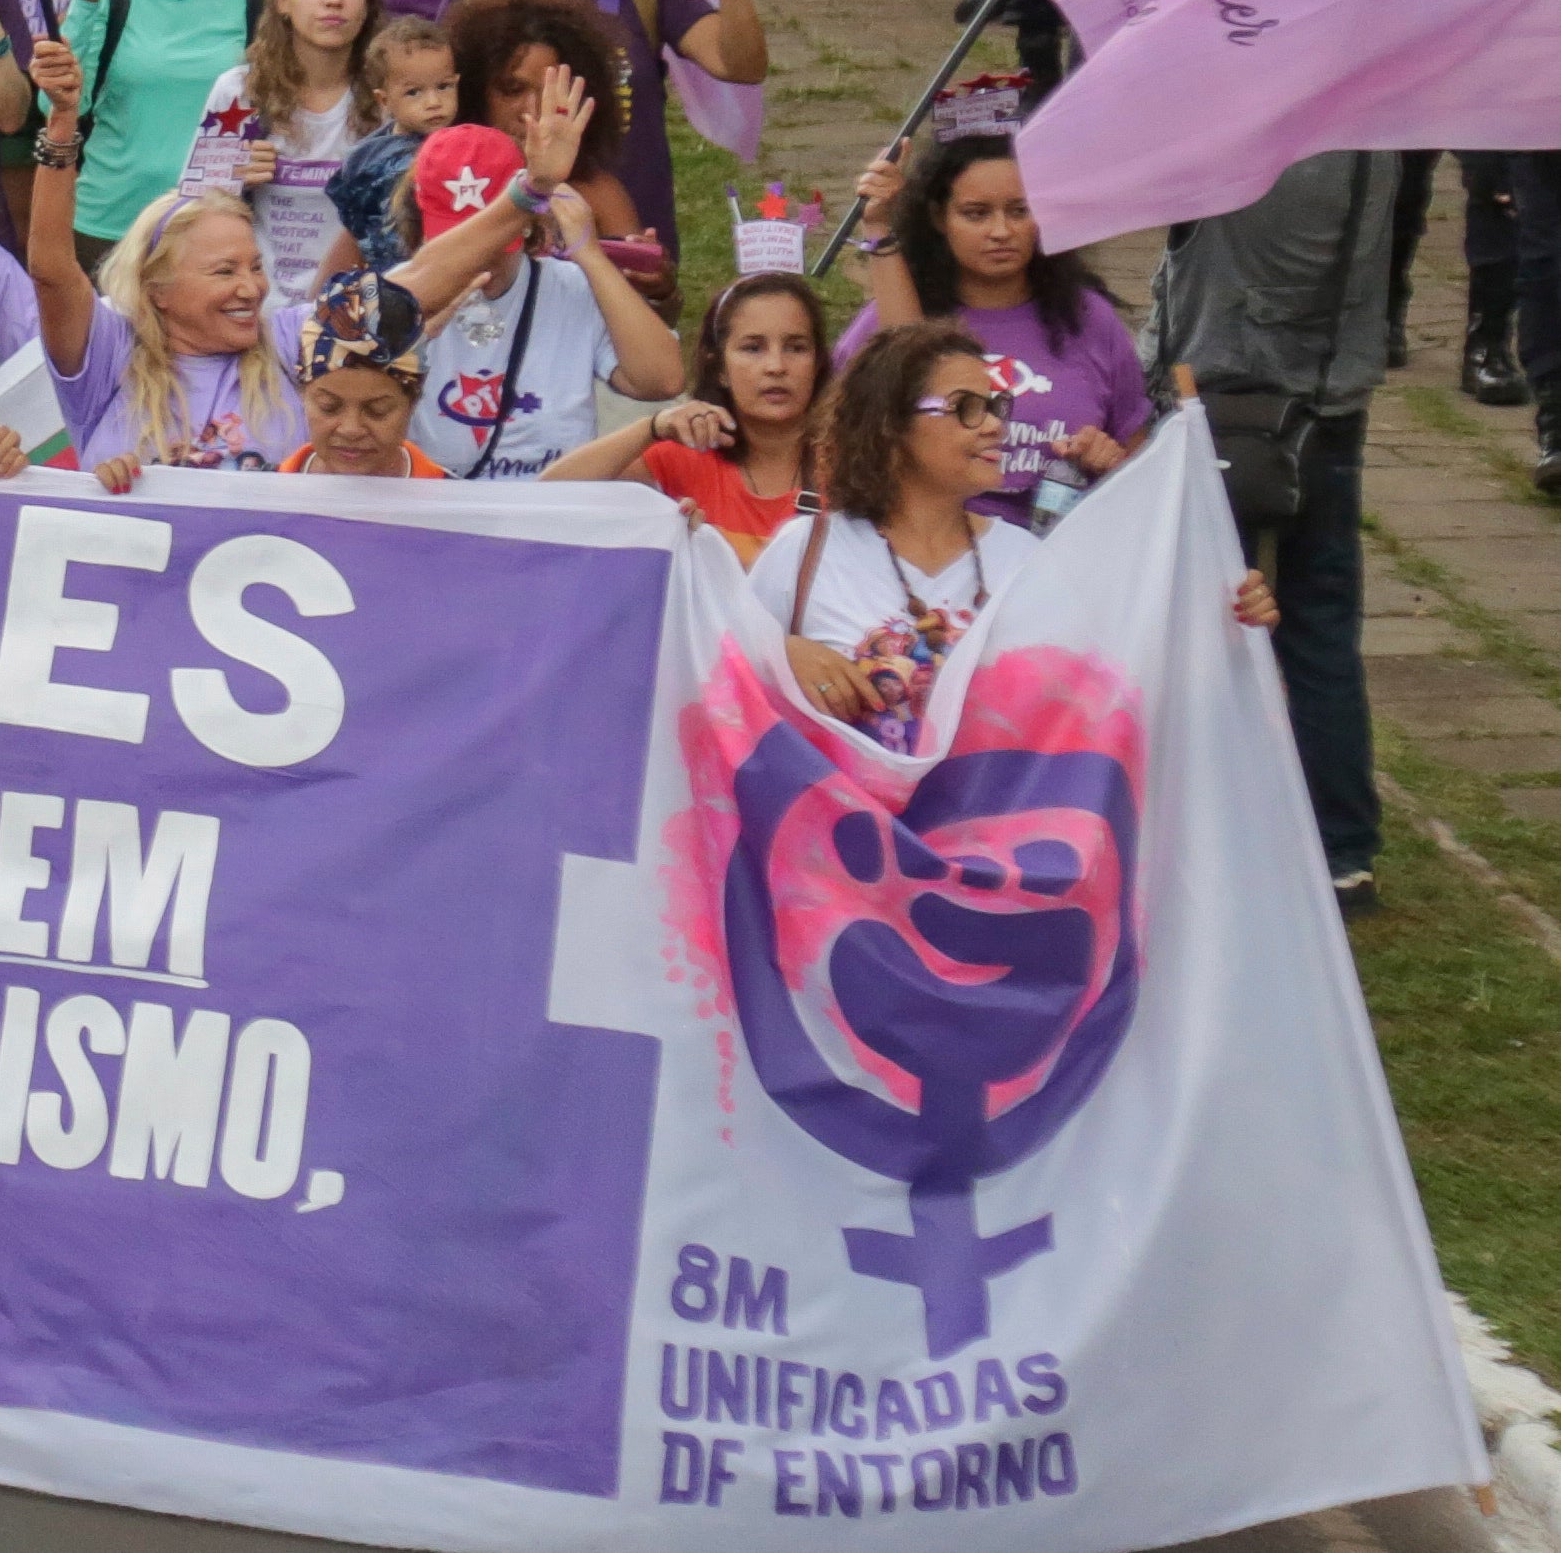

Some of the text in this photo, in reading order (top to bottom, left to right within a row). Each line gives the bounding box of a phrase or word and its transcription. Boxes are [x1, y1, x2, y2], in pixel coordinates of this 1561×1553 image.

[460, 183, 478, 197] PT
[669, 1242, 792, 1337] 8M
[658, 1342, 1068, 1442] UNIFICADAS
[658, 1430, 1080, 1520] DF ENTORNO
